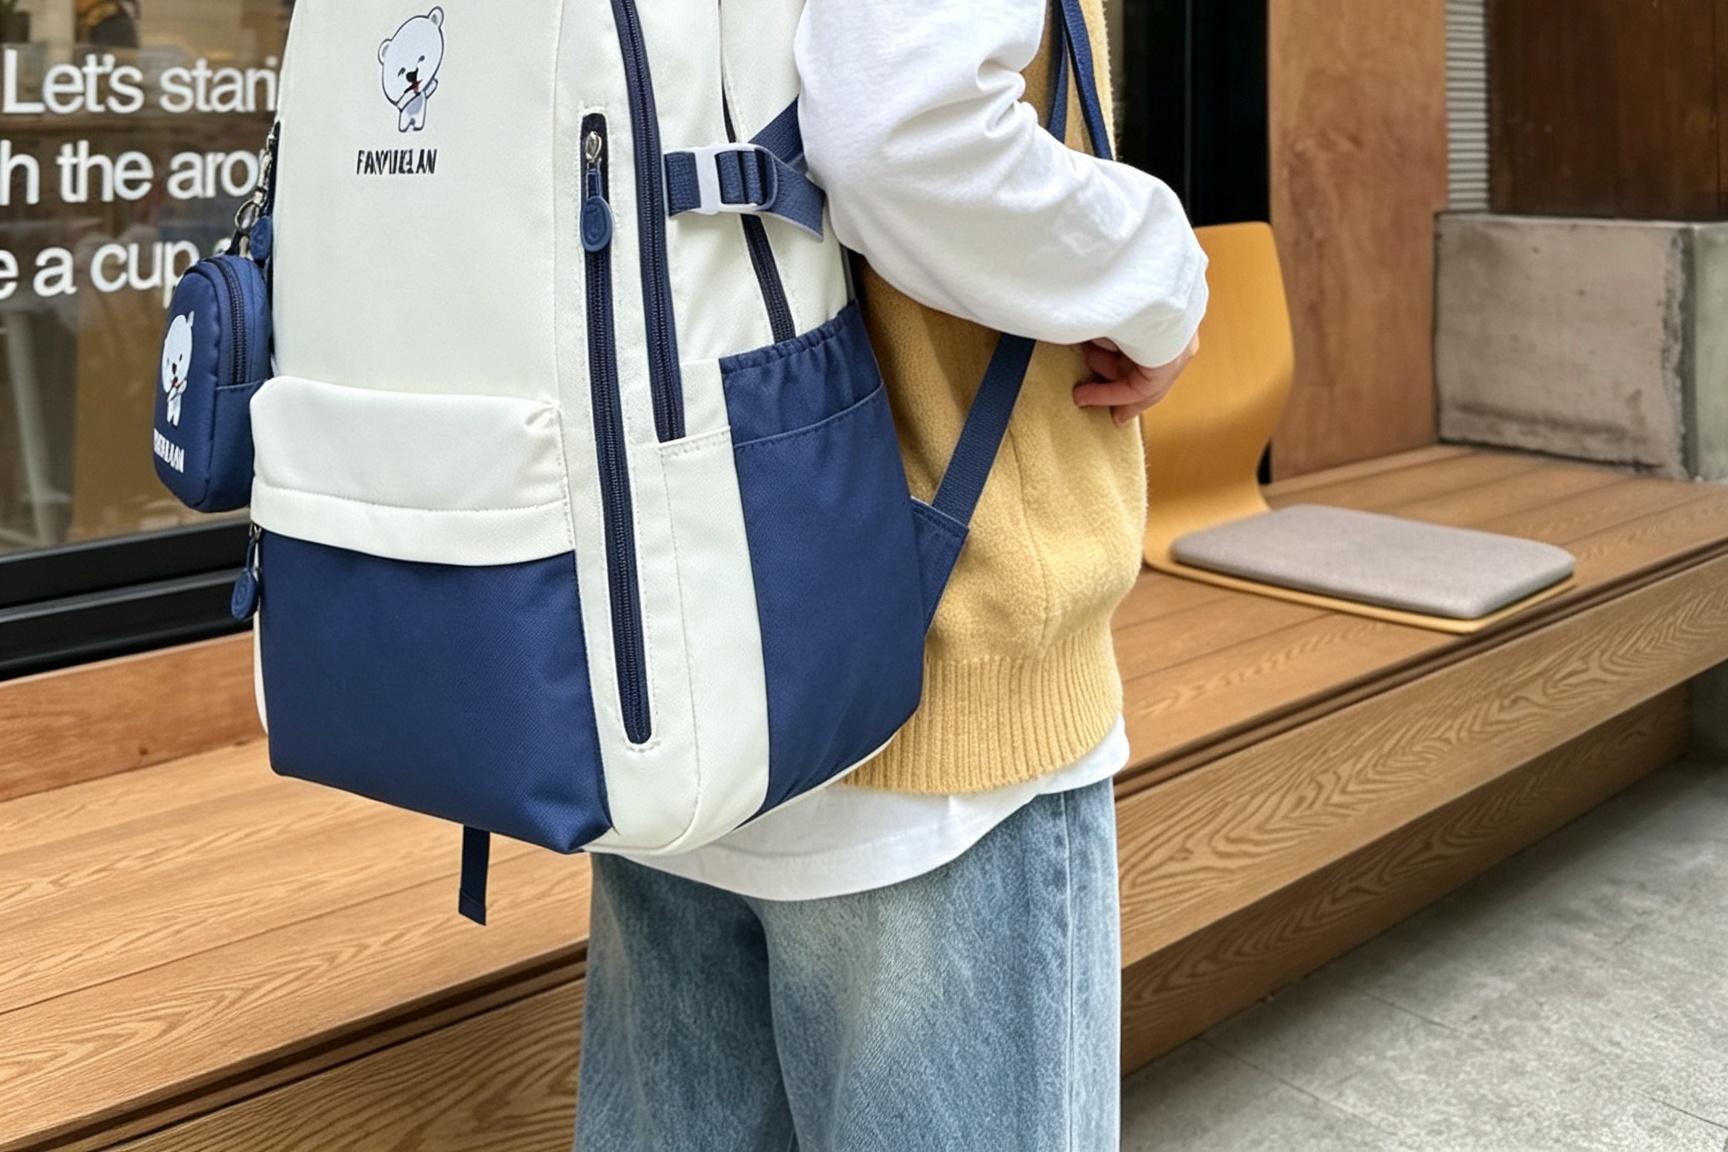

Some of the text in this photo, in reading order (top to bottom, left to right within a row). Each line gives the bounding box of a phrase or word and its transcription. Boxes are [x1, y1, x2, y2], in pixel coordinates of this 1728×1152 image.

[3, 49, 145, 114] Let's
[56, 140, 154, 202] the
[33, 247, 77, 297] a
[90, 240, 200, 309] cup
